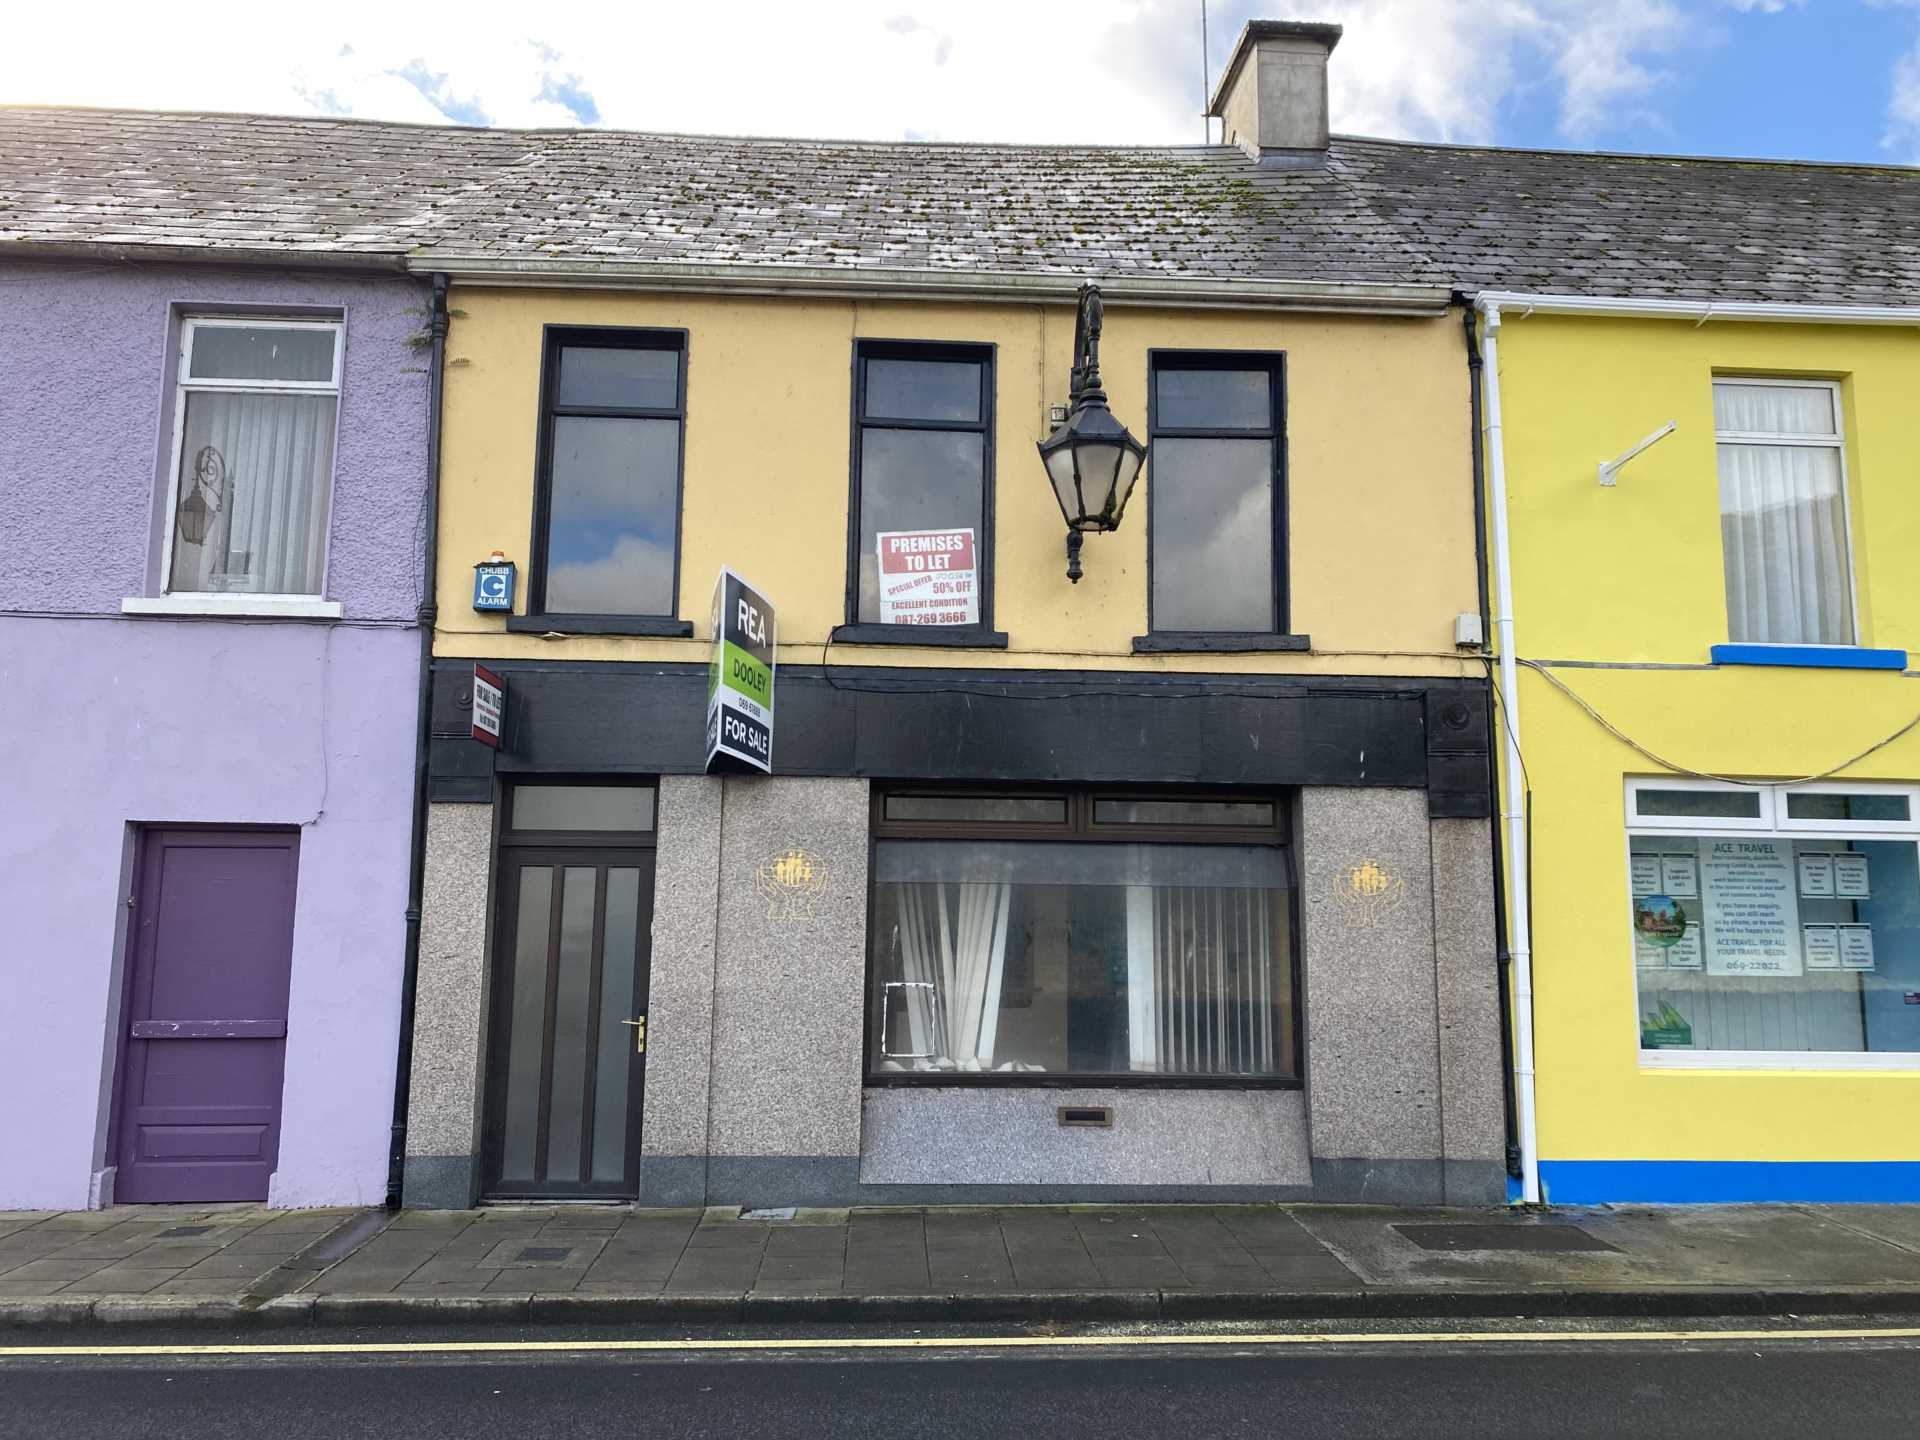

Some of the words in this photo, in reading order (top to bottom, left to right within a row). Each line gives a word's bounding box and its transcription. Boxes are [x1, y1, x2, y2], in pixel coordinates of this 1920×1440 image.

[890, 535, 964, 553] PREMISES
[905, 555, 925, 571] TO
[927, 554, 951, 570] LET
[480, 567, 510, 575] CHUBB
[887, 582, 914, 597] SPECIAL
[914, 575, 934, 587] OFFER
[932, 582, 954, 594] 50%
[955, 581, 972, 593] OFF
[477, 598, 508, 606] ALARM
[891, 600, 928, 610] EXCELLENT
[929, 598, 968, 609] CONDITION
[737, 598, 766, 649] REA
[940, 611, 967, 623] 3666
[734, 657, 767, 694] DOOLEY
[725, 715, 746, 744] FOR
[748, 726, 768, 755] SALE
[1714, 843, 1733, 853] ACE
[1738, 843, 1775, 853] TRAVEL
